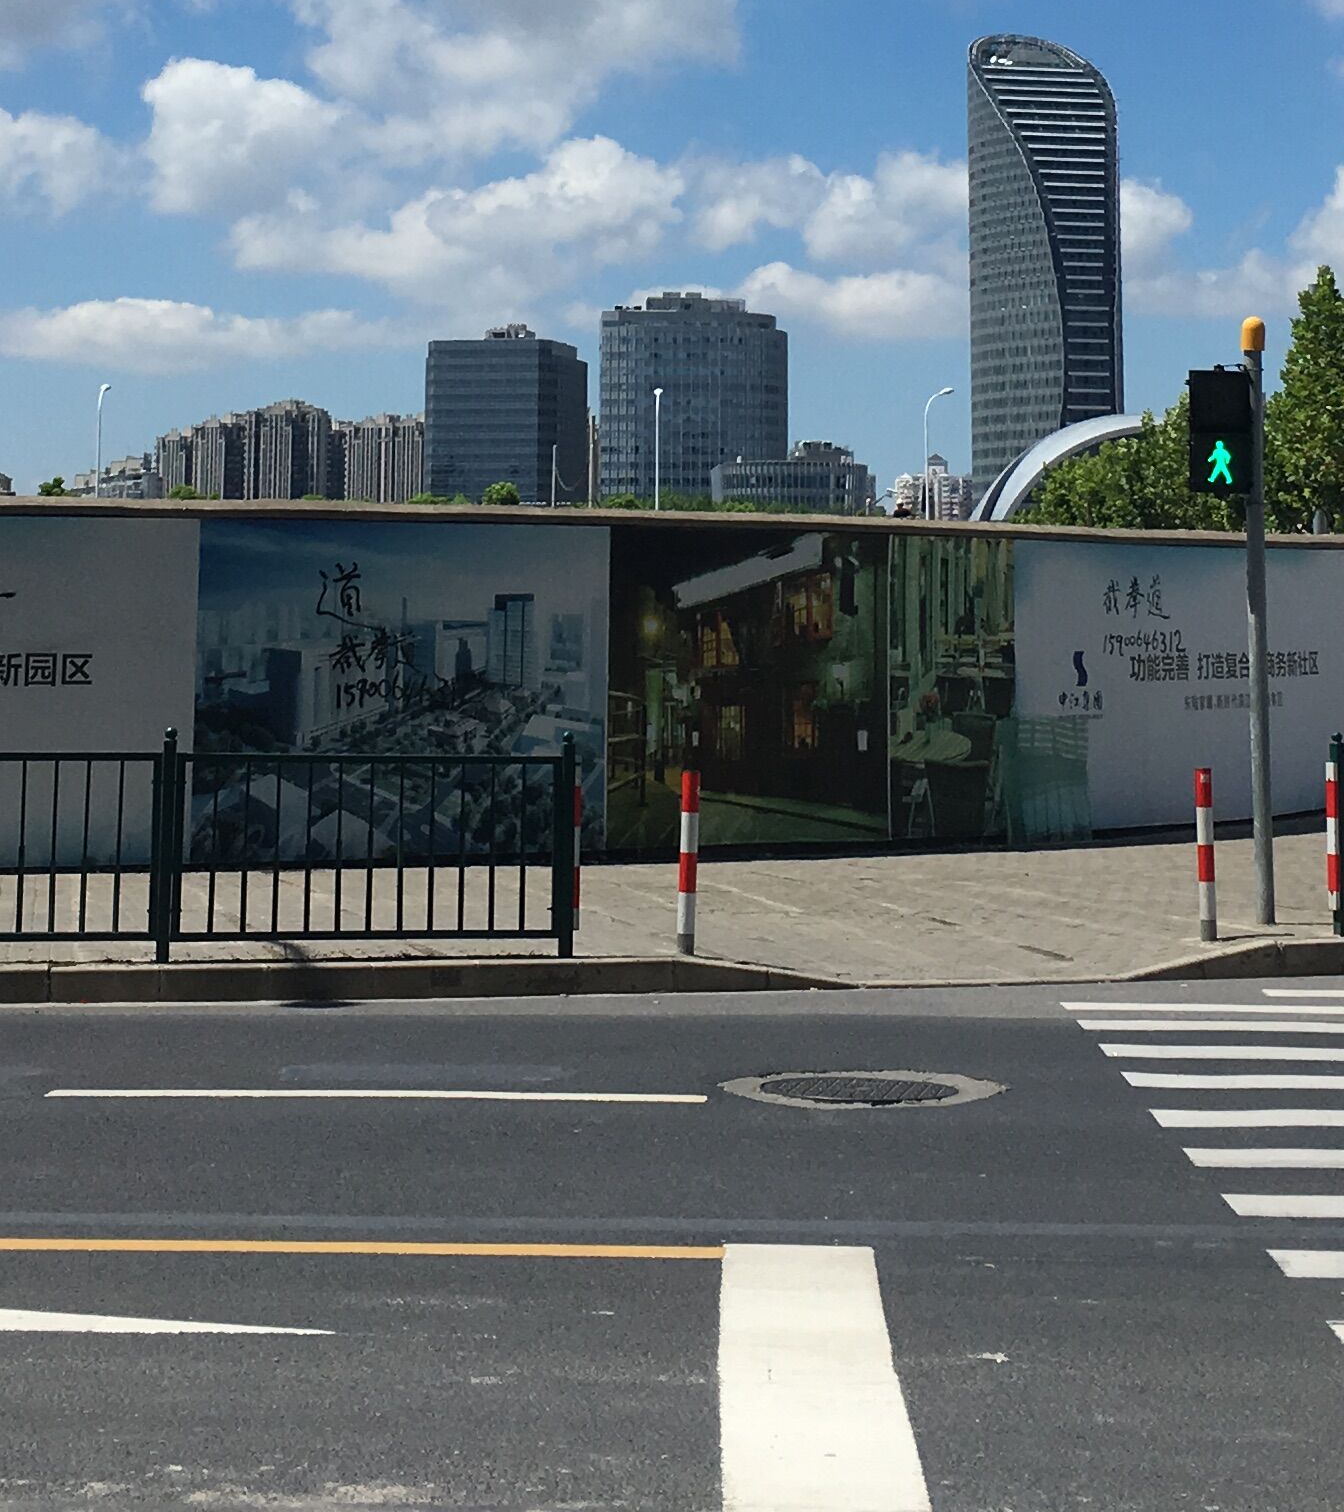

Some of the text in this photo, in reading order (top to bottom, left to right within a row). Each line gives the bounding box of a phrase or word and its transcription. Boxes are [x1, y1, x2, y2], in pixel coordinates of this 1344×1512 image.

[316, 561, 383, 632] 道
[1103, 629, 1186, 656] 15900646312
[1130, 651, 1320, 682] 功能完善 打造复合商务新社区
